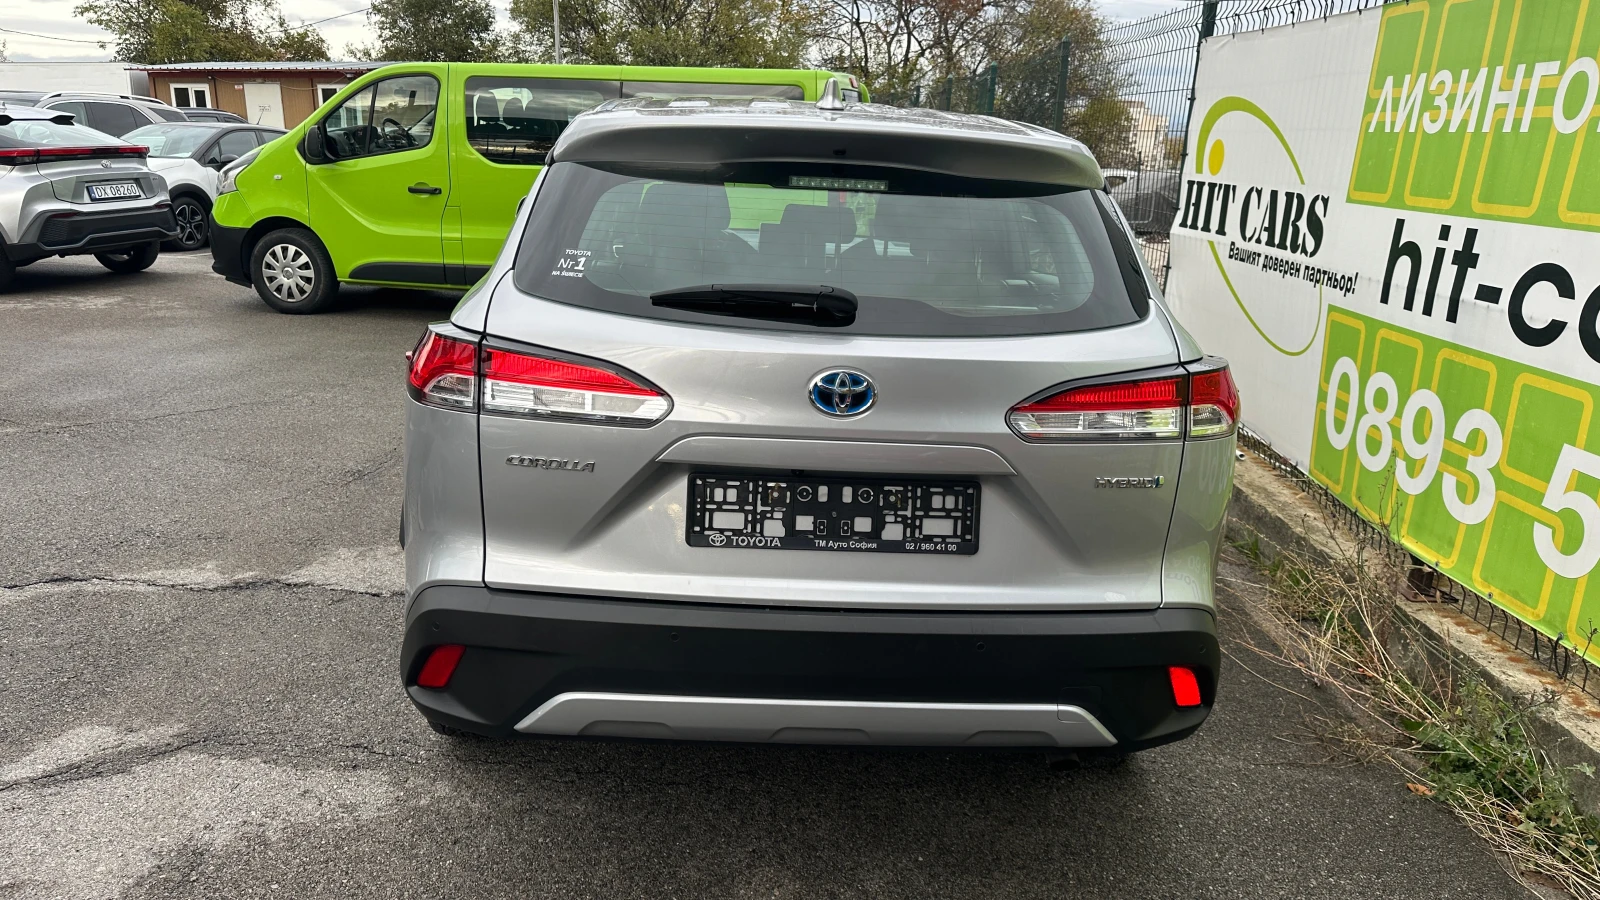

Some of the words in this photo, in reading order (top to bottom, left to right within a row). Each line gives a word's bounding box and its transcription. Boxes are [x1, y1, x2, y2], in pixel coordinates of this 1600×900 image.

[1368, 57, 1600, 134] ЛИЗИНГО
[95, 187, 109, 197] DX
[110, 185, 137, 195] 08260
[1179, 180, 1237, 236] HIT
[1239, 186, 1330, 258] CARS
[557, 258, 575, 268] Nr
[574, 257, 586, 270] 1
[1228, 241, 1262, 267] Вашият
[1261, 254, 1301, 279] доверен
[1303, 264, 1359, 297] партньор!
[1325, 356, 1503, 525] 0893
[505, 454, 595, 472] COROLLA
[1094, 477, 1155, 489] HYBRID
[730, 536, 781, 547] TOYOTA
[827, 541, 848, 549] Ауто
[849, 541, 878, 550] София
[921, 543, 935, 551] 960
[947, 544, 958, 552] 00
